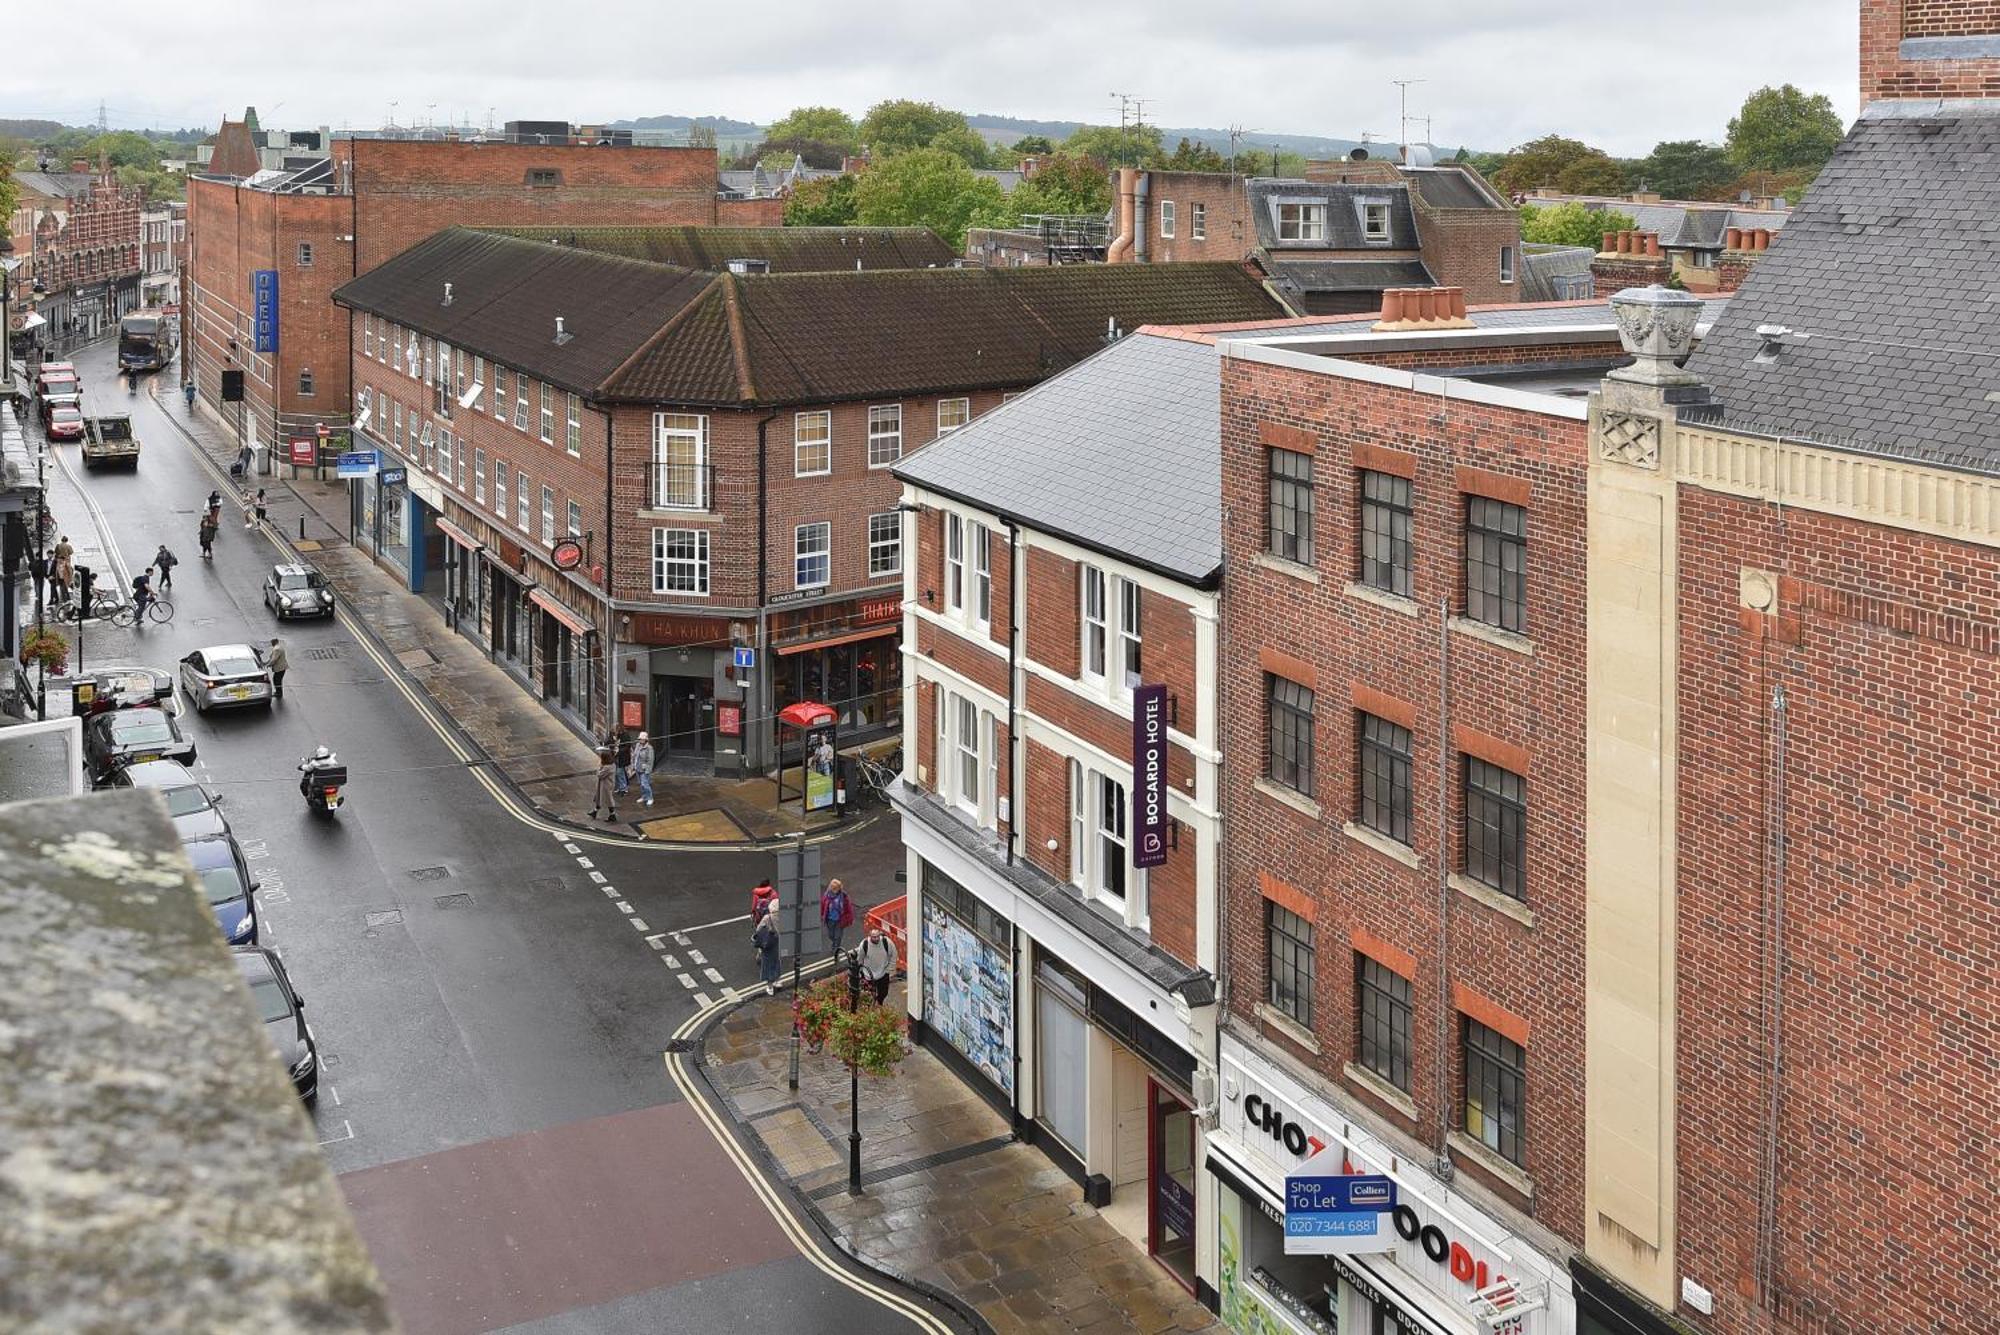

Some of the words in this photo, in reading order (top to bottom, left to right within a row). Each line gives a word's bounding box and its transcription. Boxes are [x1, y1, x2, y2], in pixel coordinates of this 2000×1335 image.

[259, 274, 270, 351] ODEON
[1146, 696, 1158, 744] HOTEL
[1146, 749, 1158, 825] BOCARDO
[1290, 1195, 1309, 1208] To
[1314, 1195, 1337, 1208] Let
[1291, 1182, 1321, 1196] Shop
[1354, 1186, 1386, 1195] Colliers
[1290, 1221, 1313, 1232] 020
[1316, 1221, 1345, 1232] 7344
[1348, 1220, 1376, 1232] 6881
[1333, 1259, 1380, 1303] NOODLES
